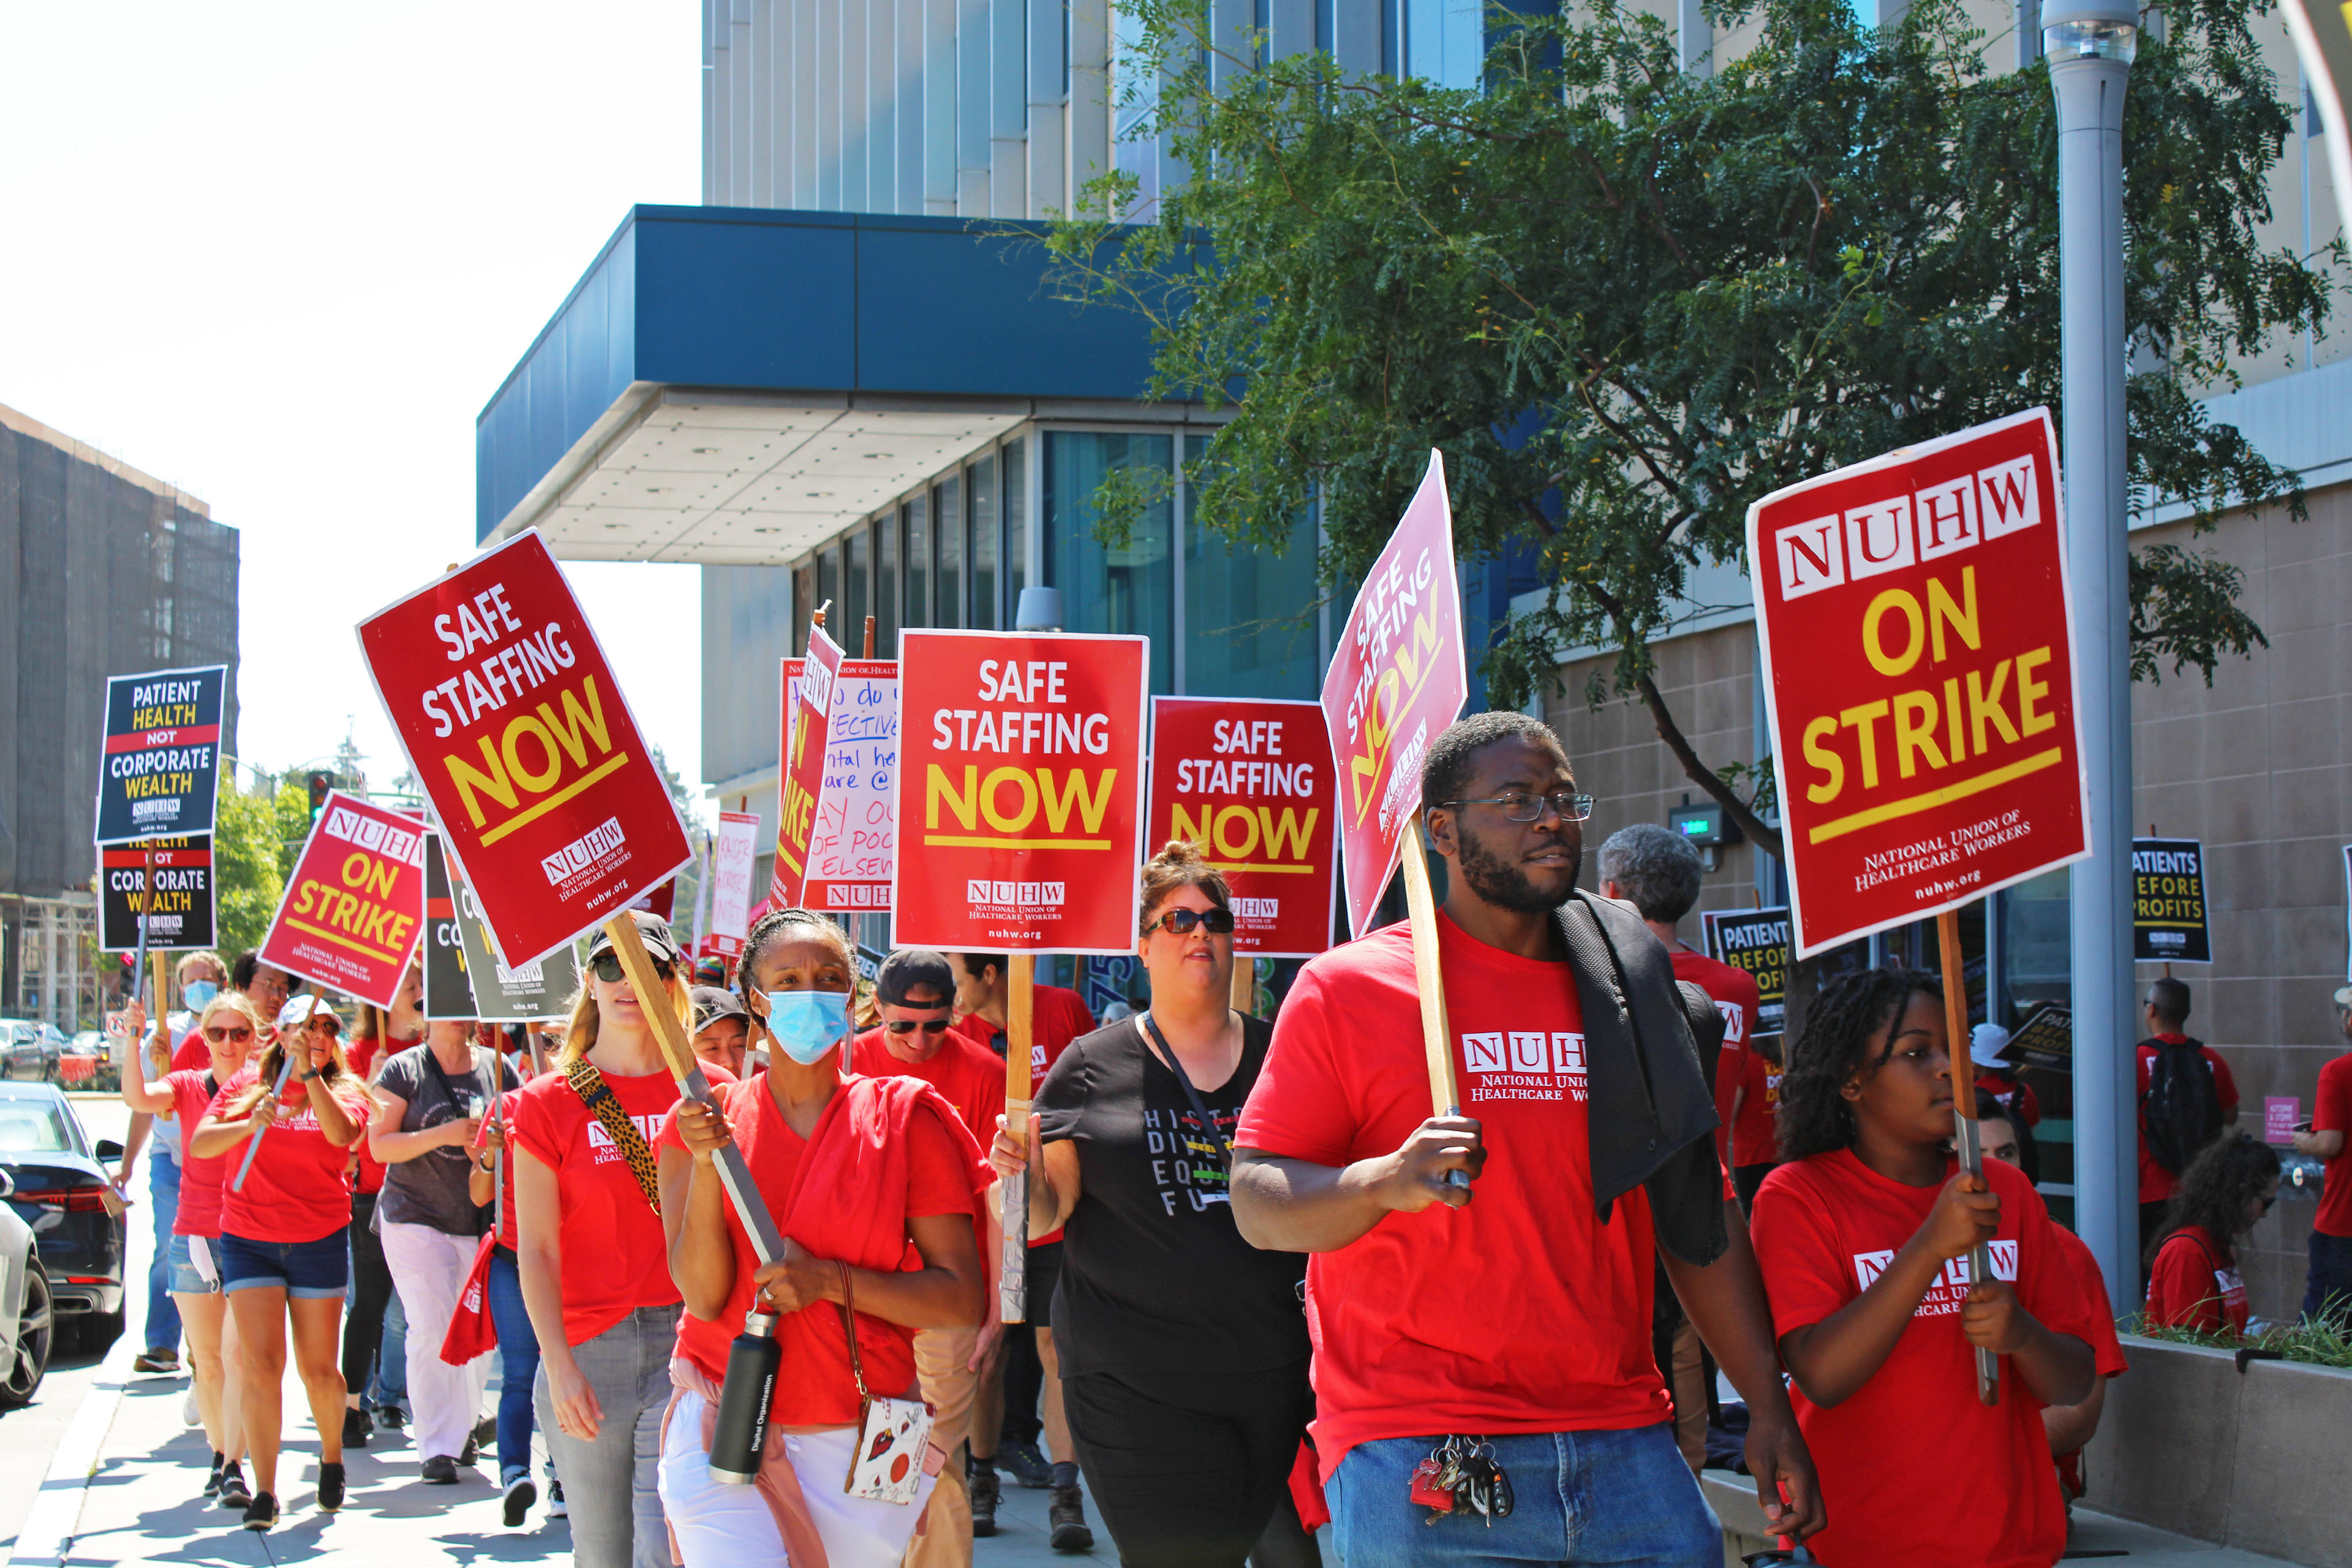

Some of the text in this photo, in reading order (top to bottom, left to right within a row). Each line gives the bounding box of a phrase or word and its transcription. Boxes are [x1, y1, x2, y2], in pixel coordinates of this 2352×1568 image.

[1781, 459, 2036, 594] NUHW
[434, 582, 522, 662] SAFE
[1357, 549, 1404, 662] SAFE
[1863, 565, 1982, 678] ON
[1347, 546, 1432, 745] STAFFING
[133, 680, 202, 708] PATIENT
[422, 622, 576, 738] STAFFING
[858, 680, 882, 707] do
[978, 660, 1067, 704] SAFE
[1351, 575, 1439, 815] NOW
[132, 704, 197, 730] HEALTH
[932, 708, 1110, 755] STAFFING
[1801, 645, 2056, 805] STRIKE
[146, 730, 177, 745] NOT
[443, 674, 612, 829] NOW
[1213, 720, 1283, 755] SAFE
[111, 747, 210, 778] CORPORATE
[1177, 759, 1314, 797] STAFFING
[1379, 719, 1427, 830] NUHW
[1400, 759, 1419, 786] UNION
[125, 772, 192, 799] WEALTH
[926, 764, 1118, 834] NOW
[134, 799, 180, 816] NUHW
[1391, 780, 1420, 838] nuhw.org
[326, 808, 422, 867] NUH
[812, 835, 839, 855] OF
[1170, 802, 1319, 861] NOW
[1864, 809, 2021, 873] NATIONAL UNION OF
[145, 852, 173, 864] OT
[543, 818, 624, 883] NUHW
[560, 845, 625, 891] NATIONAL UNION OF
[1854, 821, 2032, 893] HEALTHCARE WORKERS
[2132, 851, 2198, 875] ATIENTS
[111, 870, 205, 891] CORORATE
[342, 853, 399, 900] ON
[559, 851, 632, 902] HEALTHCARE WORKERS
[586, 878, 628, 910] nuhw.org
[968, 881, 1064, 904] NUHW
[1915, 870, 1981, 900] nuhw.org
[2136, 876, 2200, 896] EFORE
[127, 892, 192, 912] WALTH
[828, 886, 891, 905] NUH
[975, 904, 1016, 913] NATIONAL
[1019, 905, 1045, 914] UNION
[2135, 898, 2202, 918] ROFITS
[138, 916, 183, 927] UHW
[293, 880, 413, 952] STRIKE
[969, 911, 1022, 920] HEALTHCARE
[989, 929, 1041, 940] nuhw.org
[513, 1002, 539, 1011] nuhw.org
[1464, 1034, 1587, 1069] NUH
[1471, 1088, 1563, 1102] HEALTHCARE
[1482, 1074, 1552, 1088] NATIONAL
[752, 1374, 774, 1452] Digital Organization
